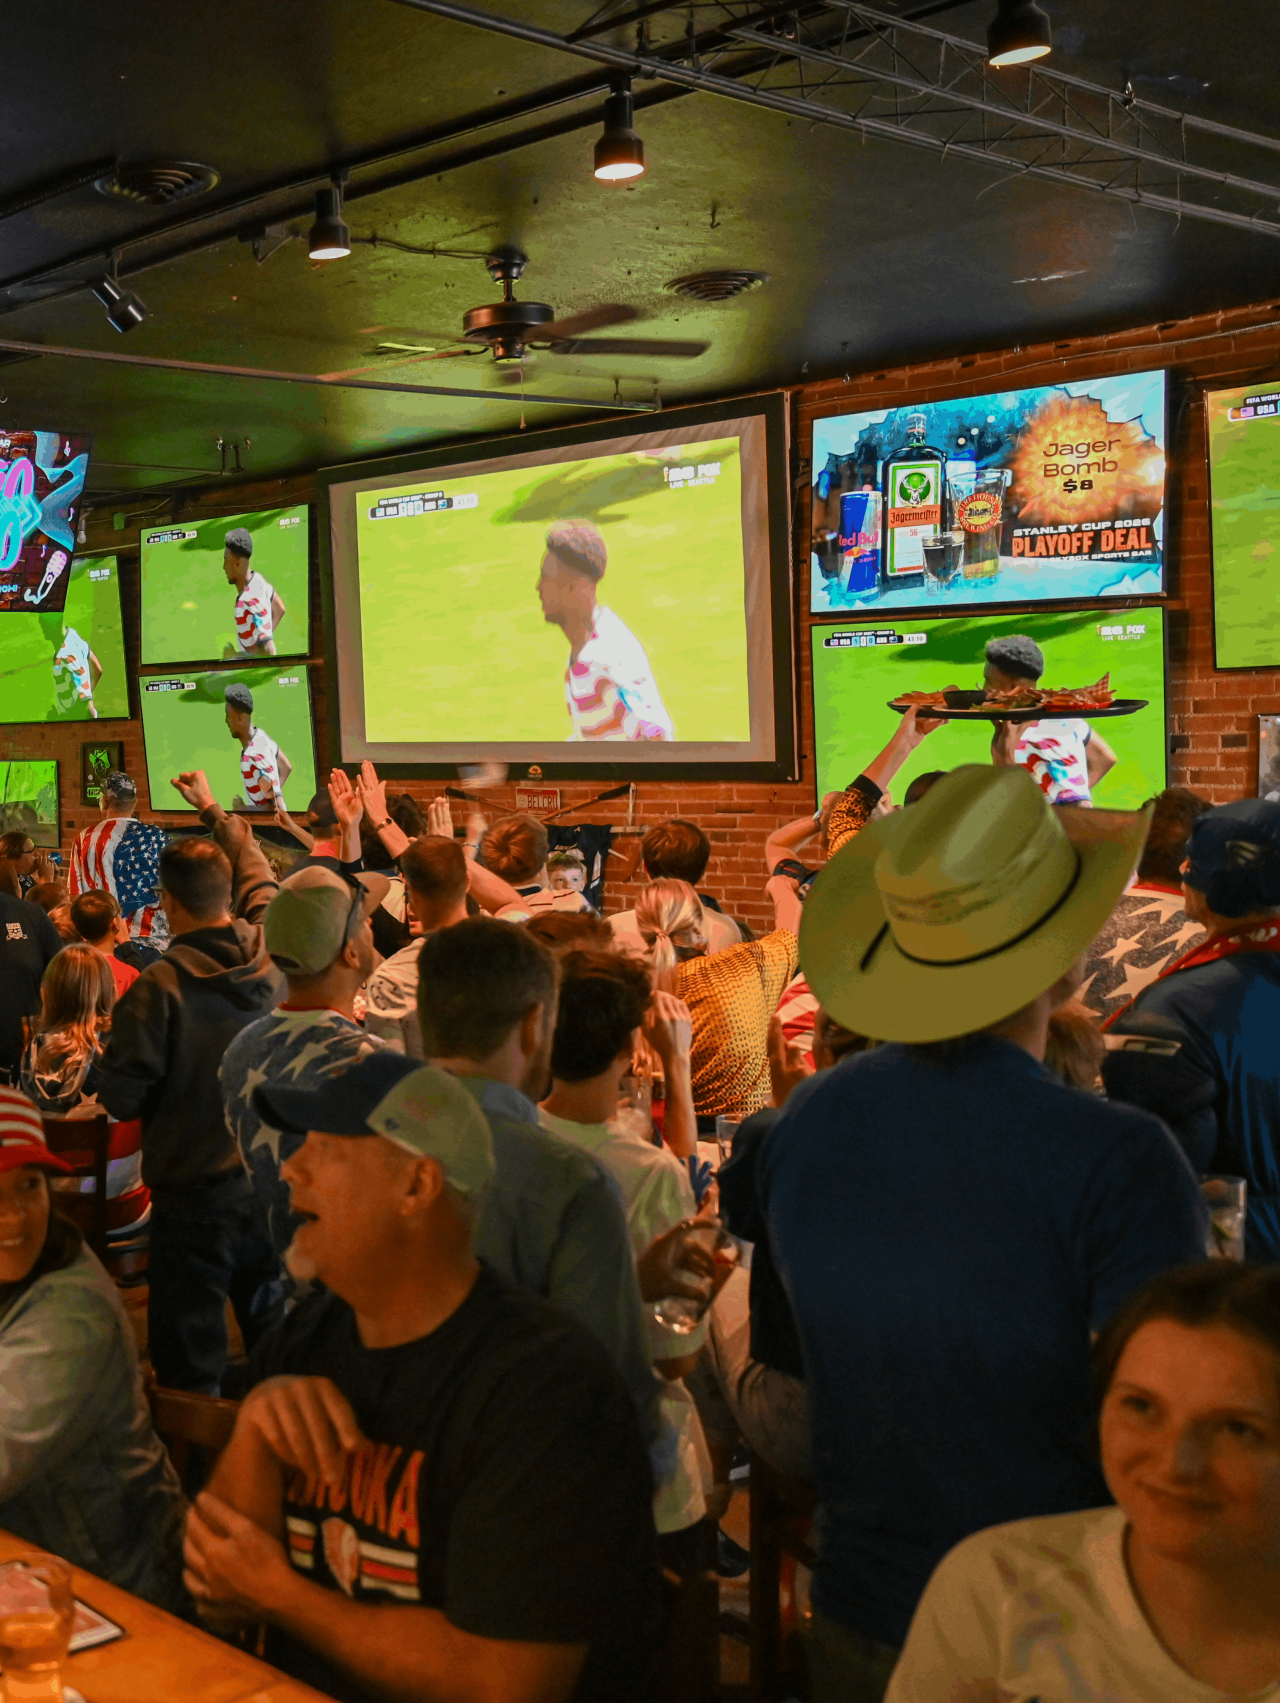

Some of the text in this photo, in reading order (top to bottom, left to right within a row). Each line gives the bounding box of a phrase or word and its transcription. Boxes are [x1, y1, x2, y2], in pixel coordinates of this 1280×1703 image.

[1261, 393, 1280, 402] WORL
[1257, 404, 1275, 414] USA
[1042, 439, 1121, 459] Jager
[1043, 457, 1119, 477] Bomb
[1062, 478, 1094, 493] $8
[1013, 524, 1079, 537] STANLEY
[1081, 521, 1111, 531] CUP
[1012, 527, 1153, 558] PLAYOFF DEAL
[1091, 551, 1130, 560] SPORTS
[1126, 624, 1146, 634] FOX
[527, 795, 558, 810] BELCRU
